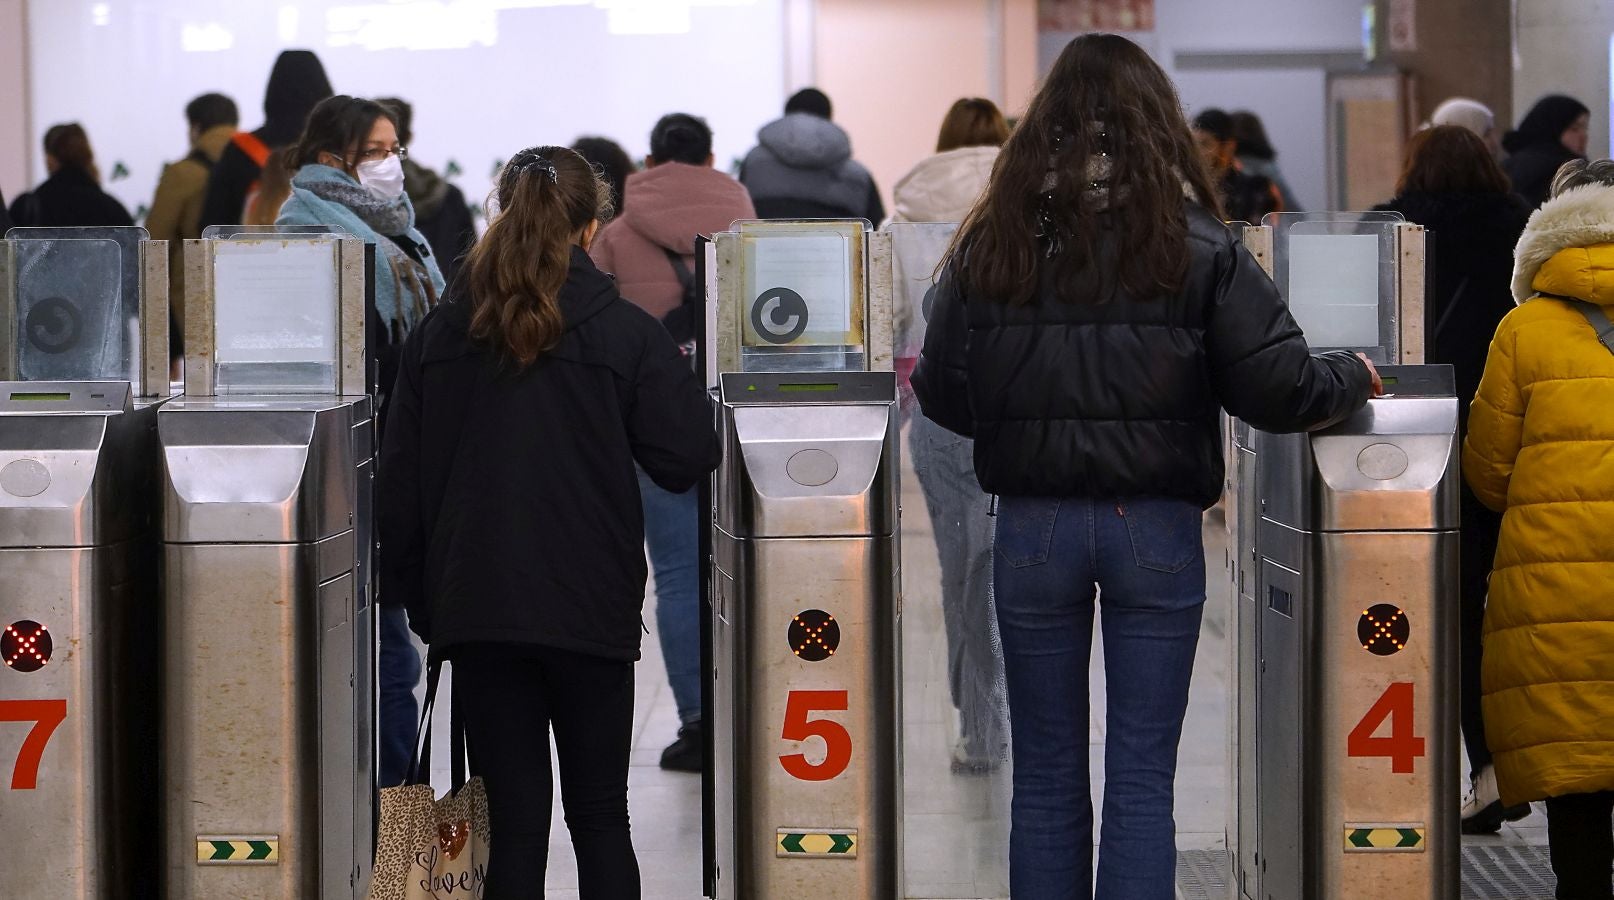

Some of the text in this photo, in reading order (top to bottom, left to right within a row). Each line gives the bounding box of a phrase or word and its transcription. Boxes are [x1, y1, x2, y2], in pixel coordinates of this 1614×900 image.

[0, 700, 67, 789] 7
[780, 691, 852, 780] 5
[1348, 682, 1424, 773] 4
